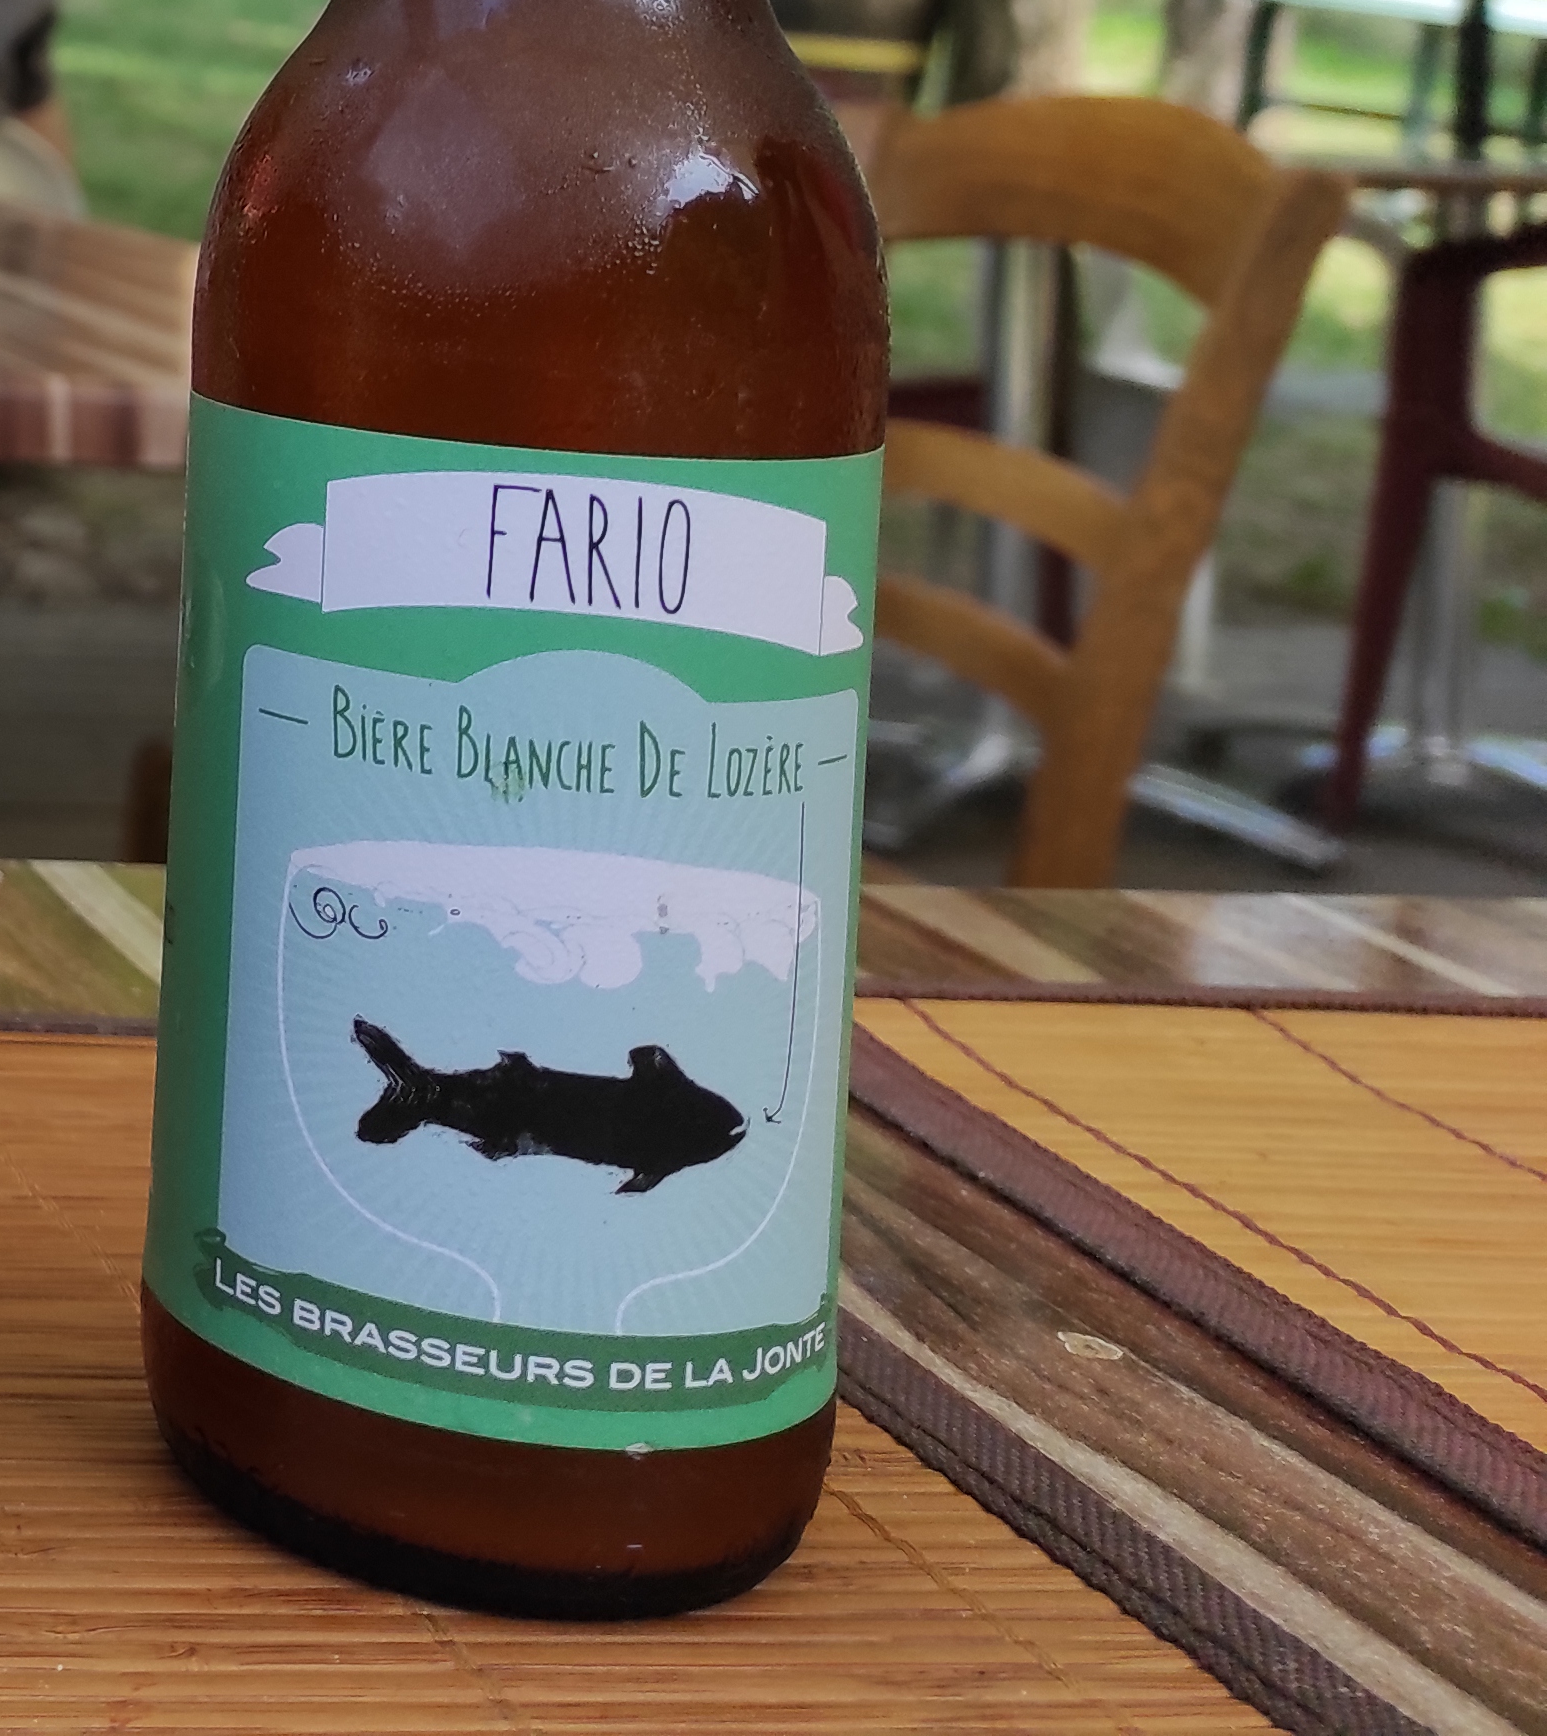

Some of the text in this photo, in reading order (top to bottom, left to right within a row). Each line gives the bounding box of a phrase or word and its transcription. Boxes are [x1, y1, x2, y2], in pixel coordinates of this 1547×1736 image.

[486, 484, 692, 614] FARIO
[215, 1257, 826, 1390] LES BRASSEURS DE LA JONTE
